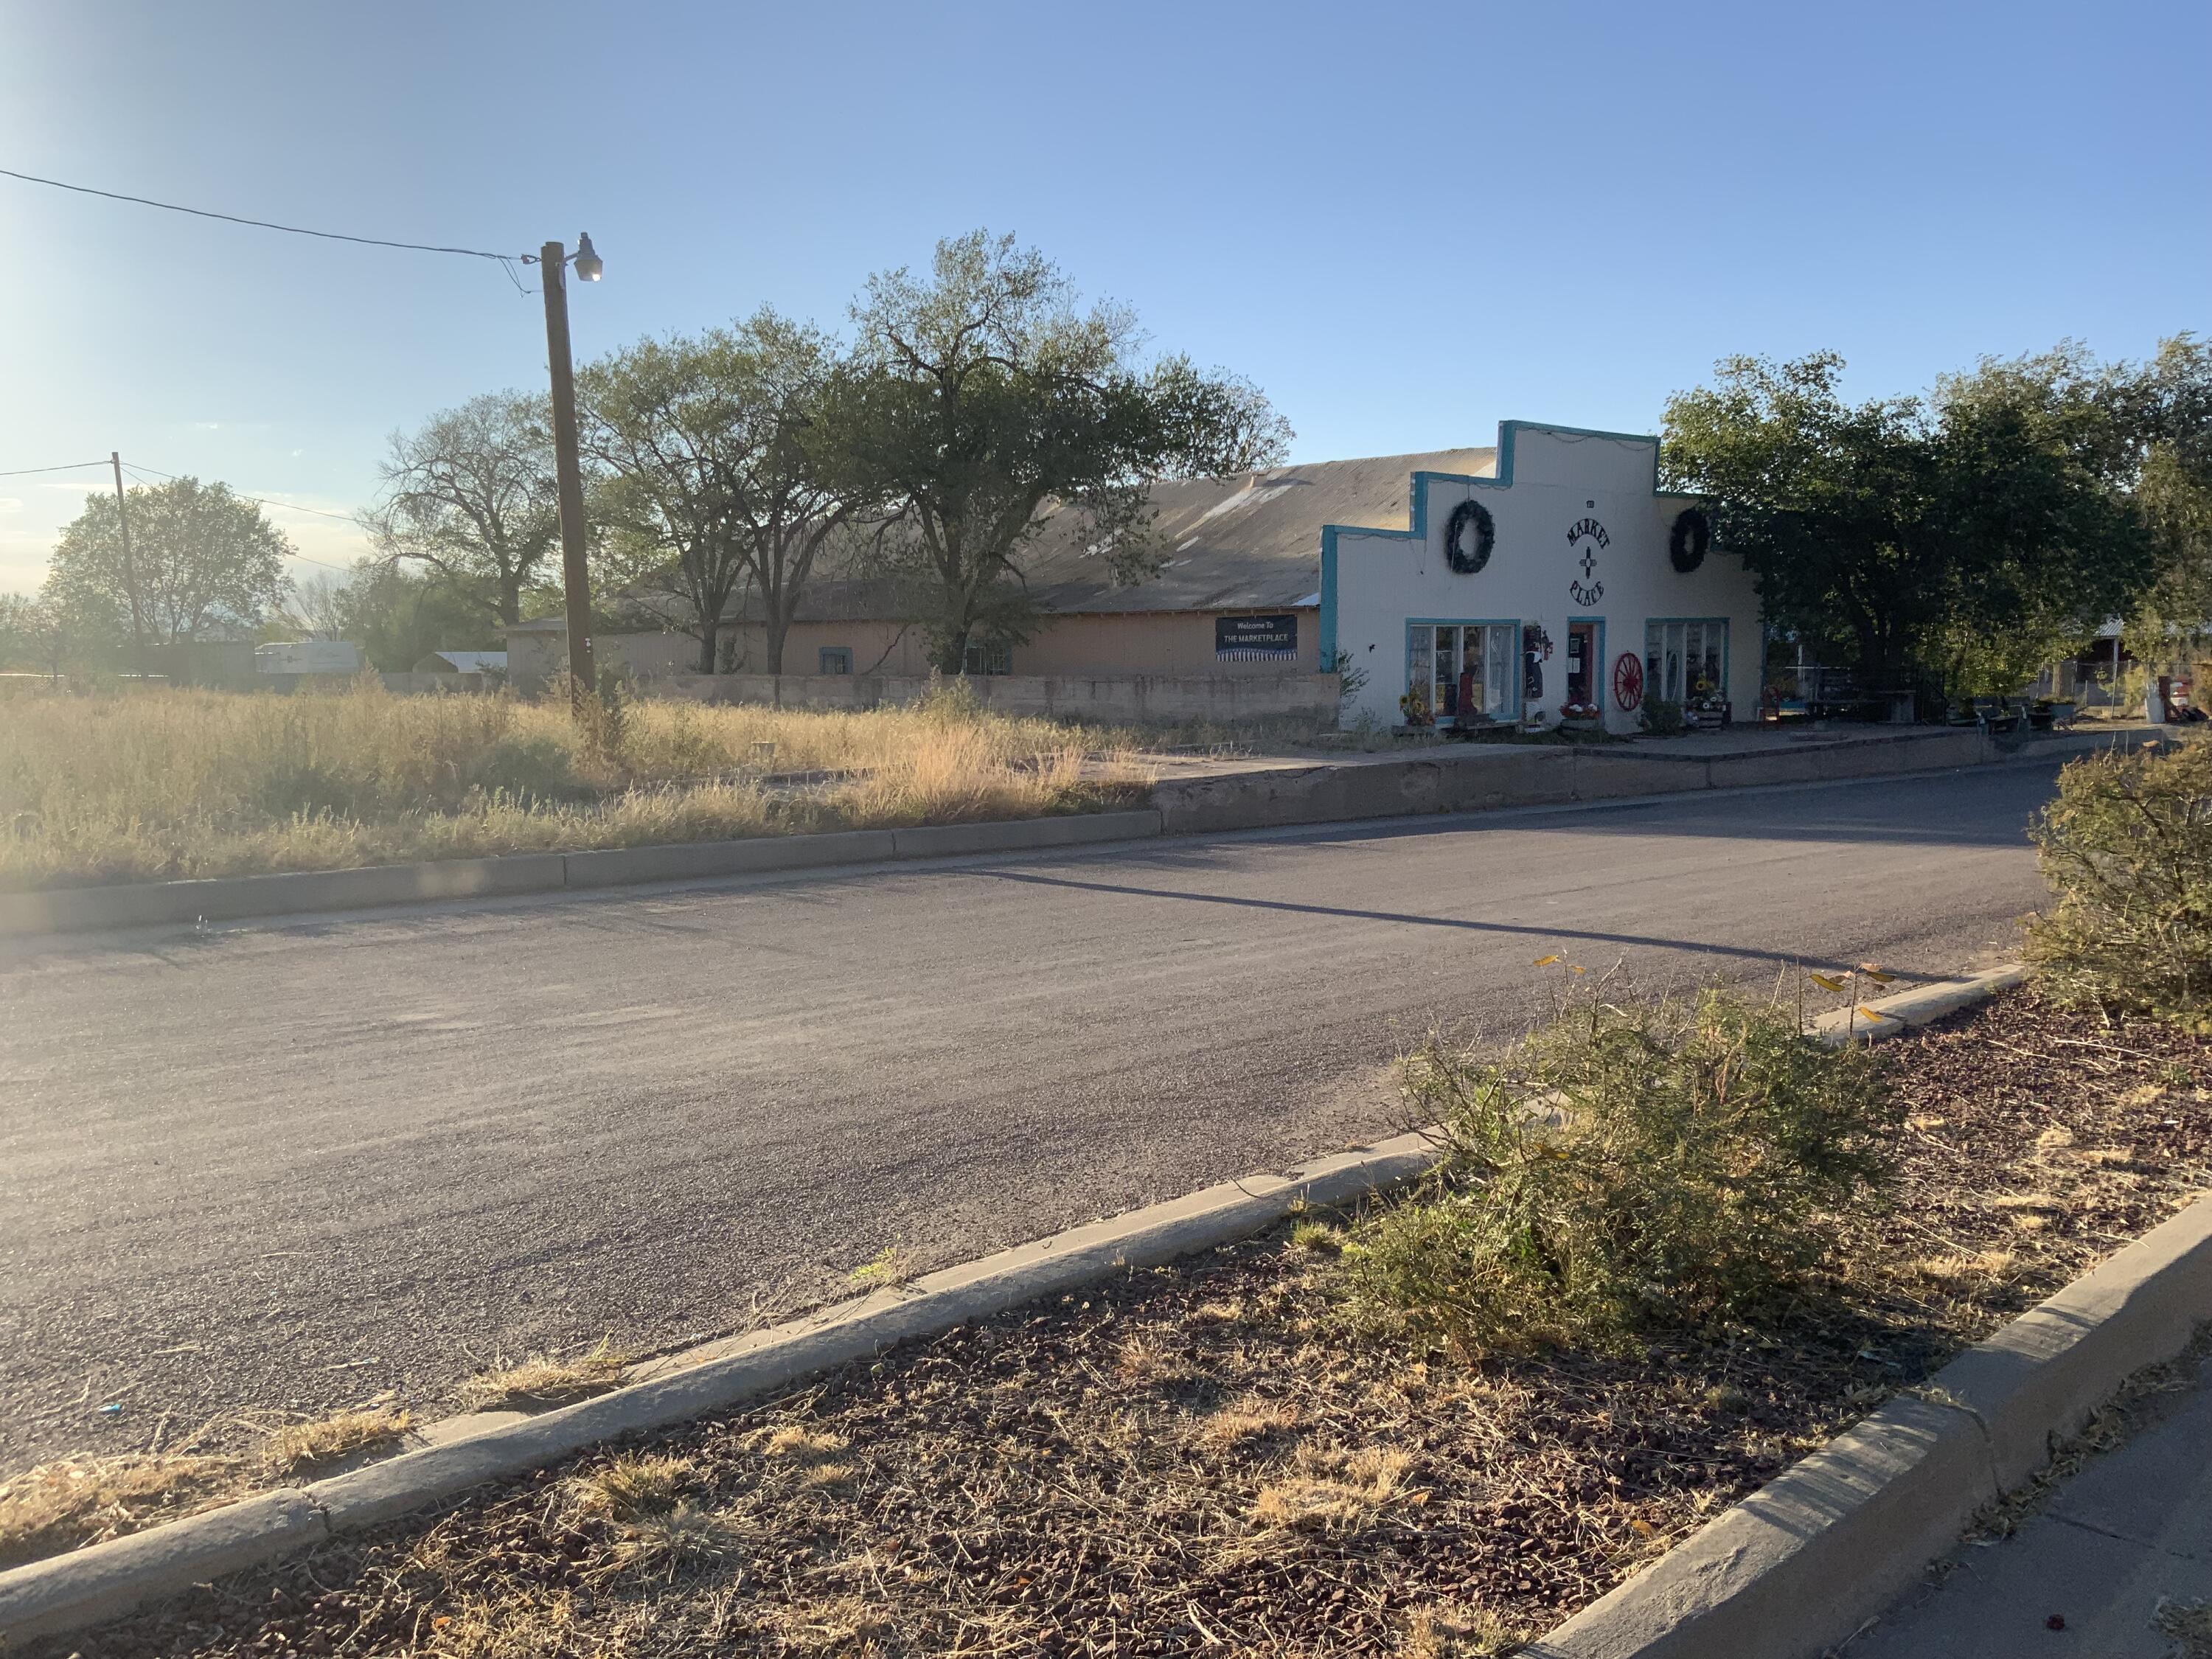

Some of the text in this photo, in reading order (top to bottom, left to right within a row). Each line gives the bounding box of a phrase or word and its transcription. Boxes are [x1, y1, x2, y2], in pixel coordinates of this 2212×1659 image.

[1567, 518, 1610, 549] MARKET
[1569, 580, 1604, 607] PLACE
[1239, 634, 1288, 642] MARKETPLACE
